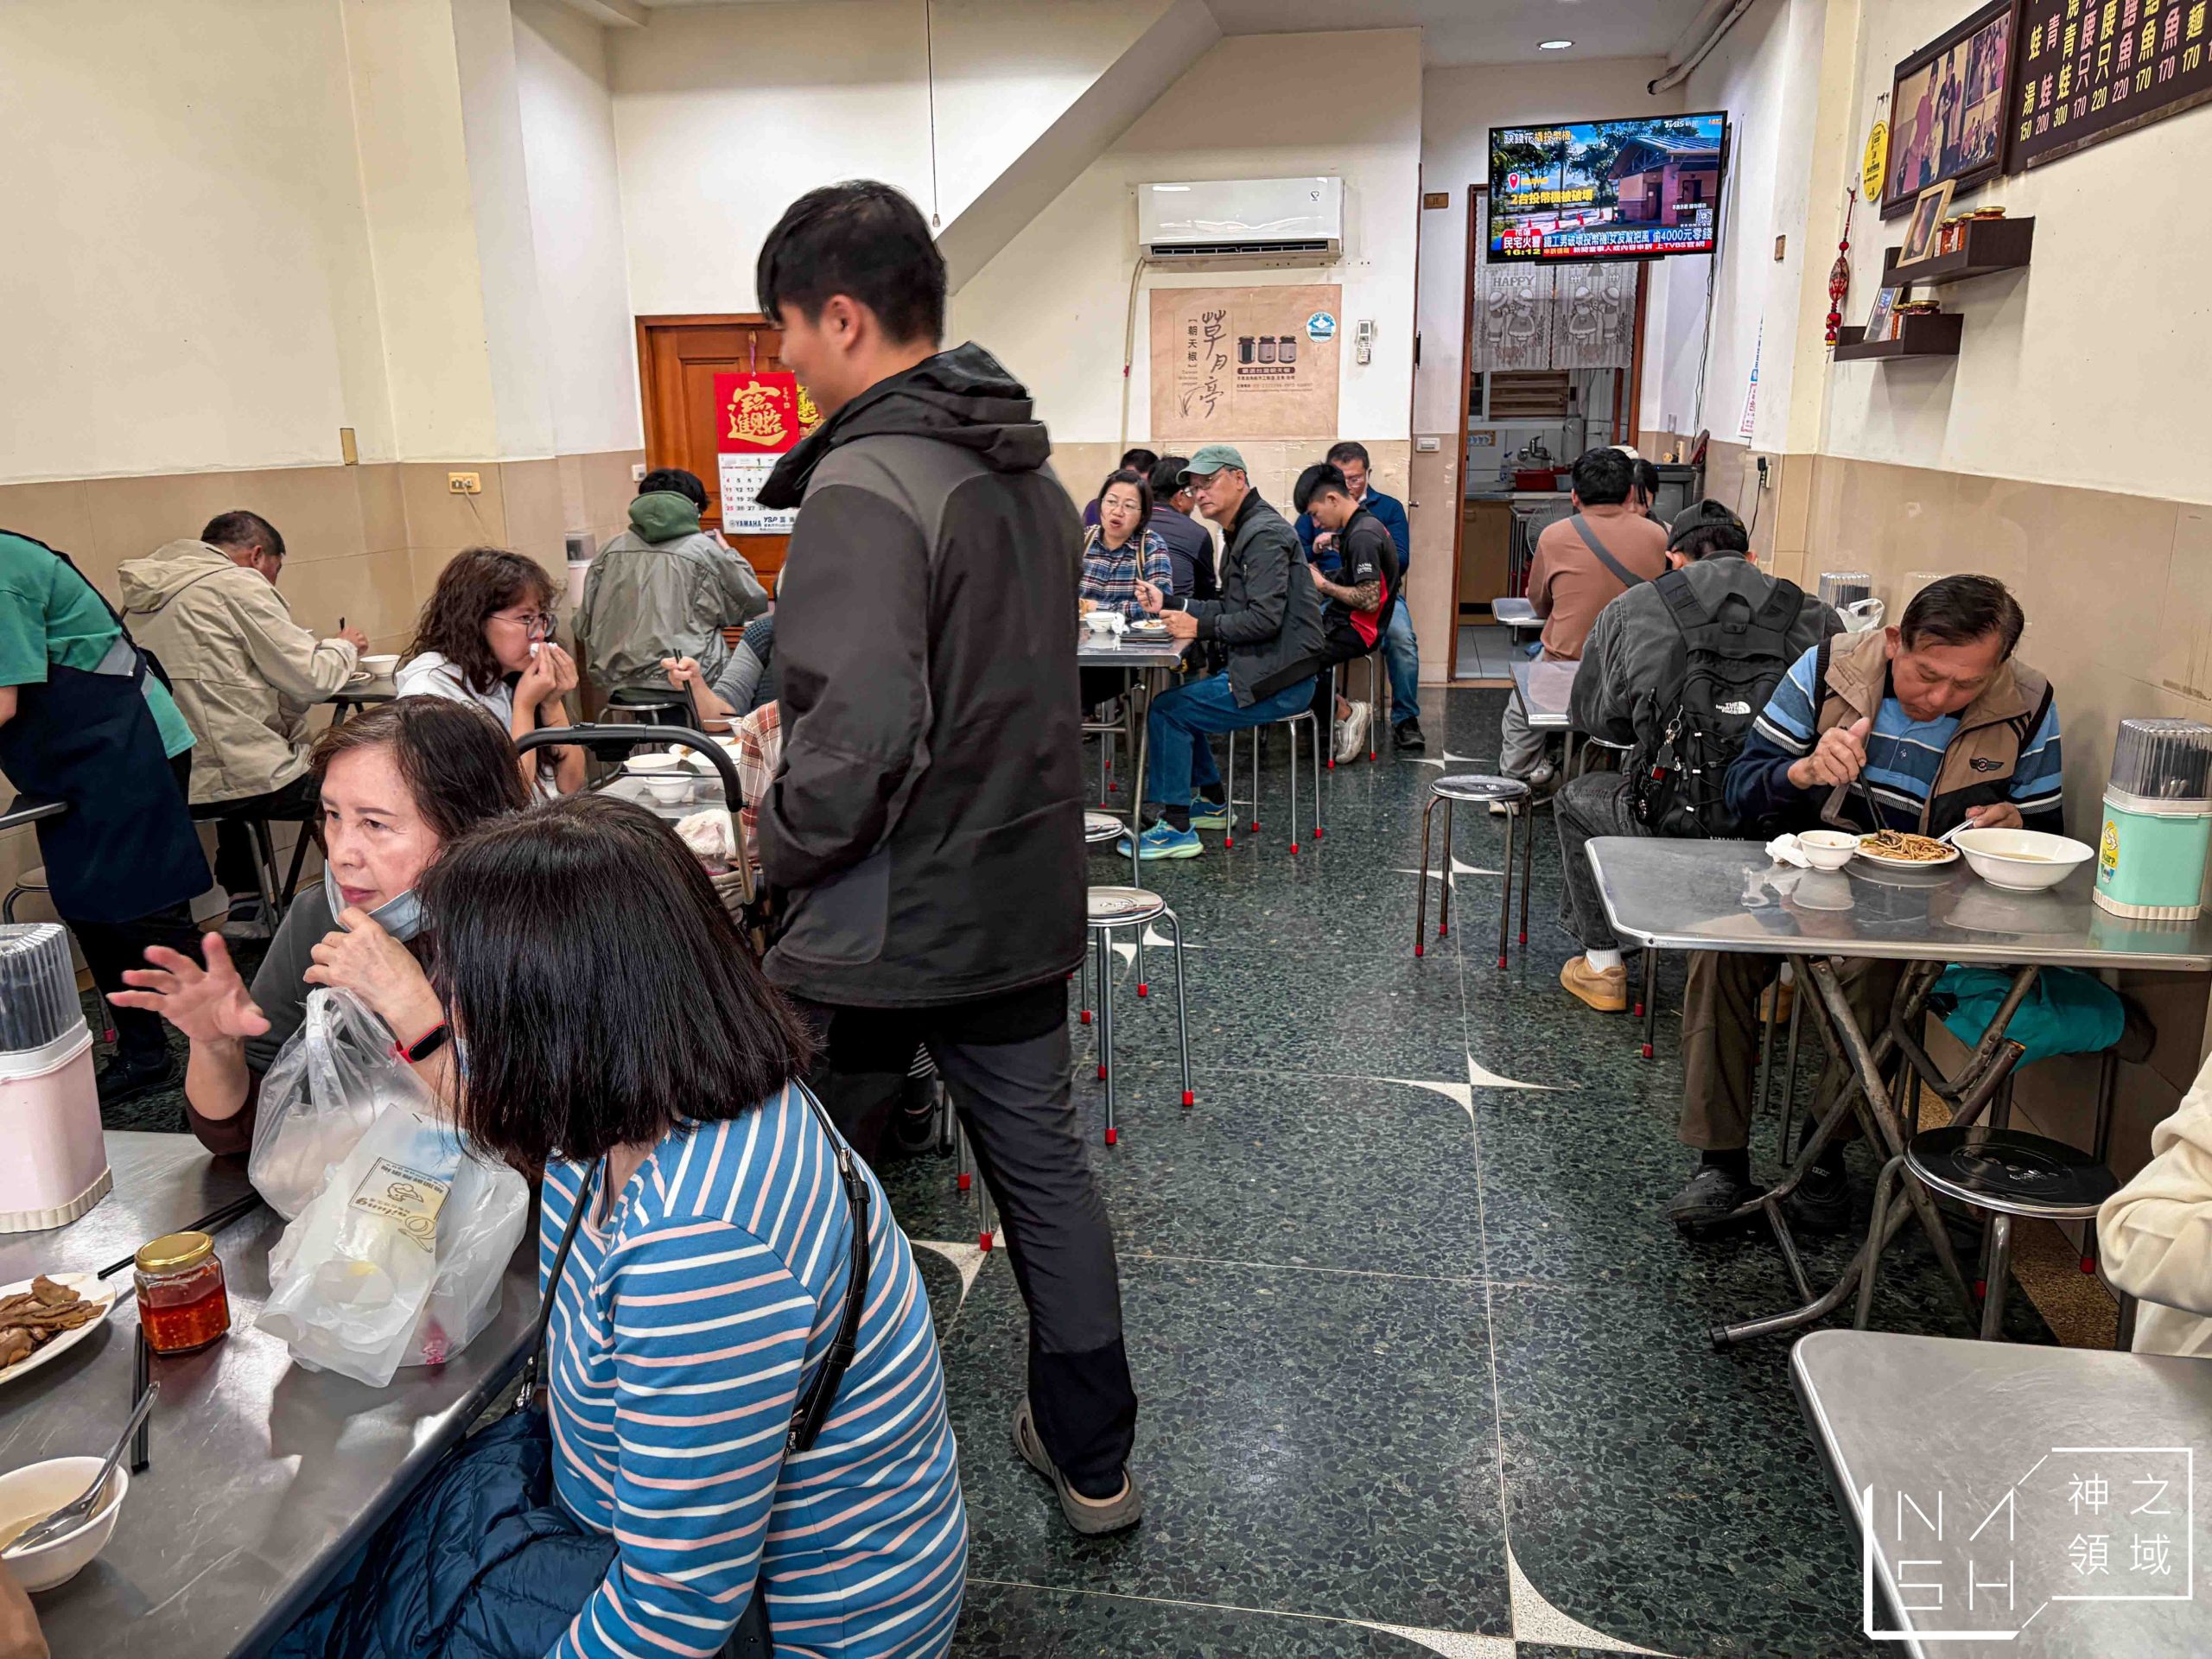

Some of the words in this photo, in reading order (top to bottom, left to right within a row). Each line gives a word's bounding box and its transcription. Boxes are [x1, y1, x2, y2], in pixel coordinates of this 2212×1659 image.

[2075, 0, 2097, 92] 腰只
[2183, 43, 2201, 73] 170
[2136, 66, 2152, 93] 170
[2158, 55, 2176, 83] 170
[2091, 86, 2107, 112] 220
[2112, 76, 2129, 103] 220
[2053, 104, 2069, 128] 300
[2073, 95, 2087, 119] 170
[2019, 120, 2032, 142] 150
[2035, 112, 2050, 135] 200
[1493, 276, 1535, 287] HAPPY
